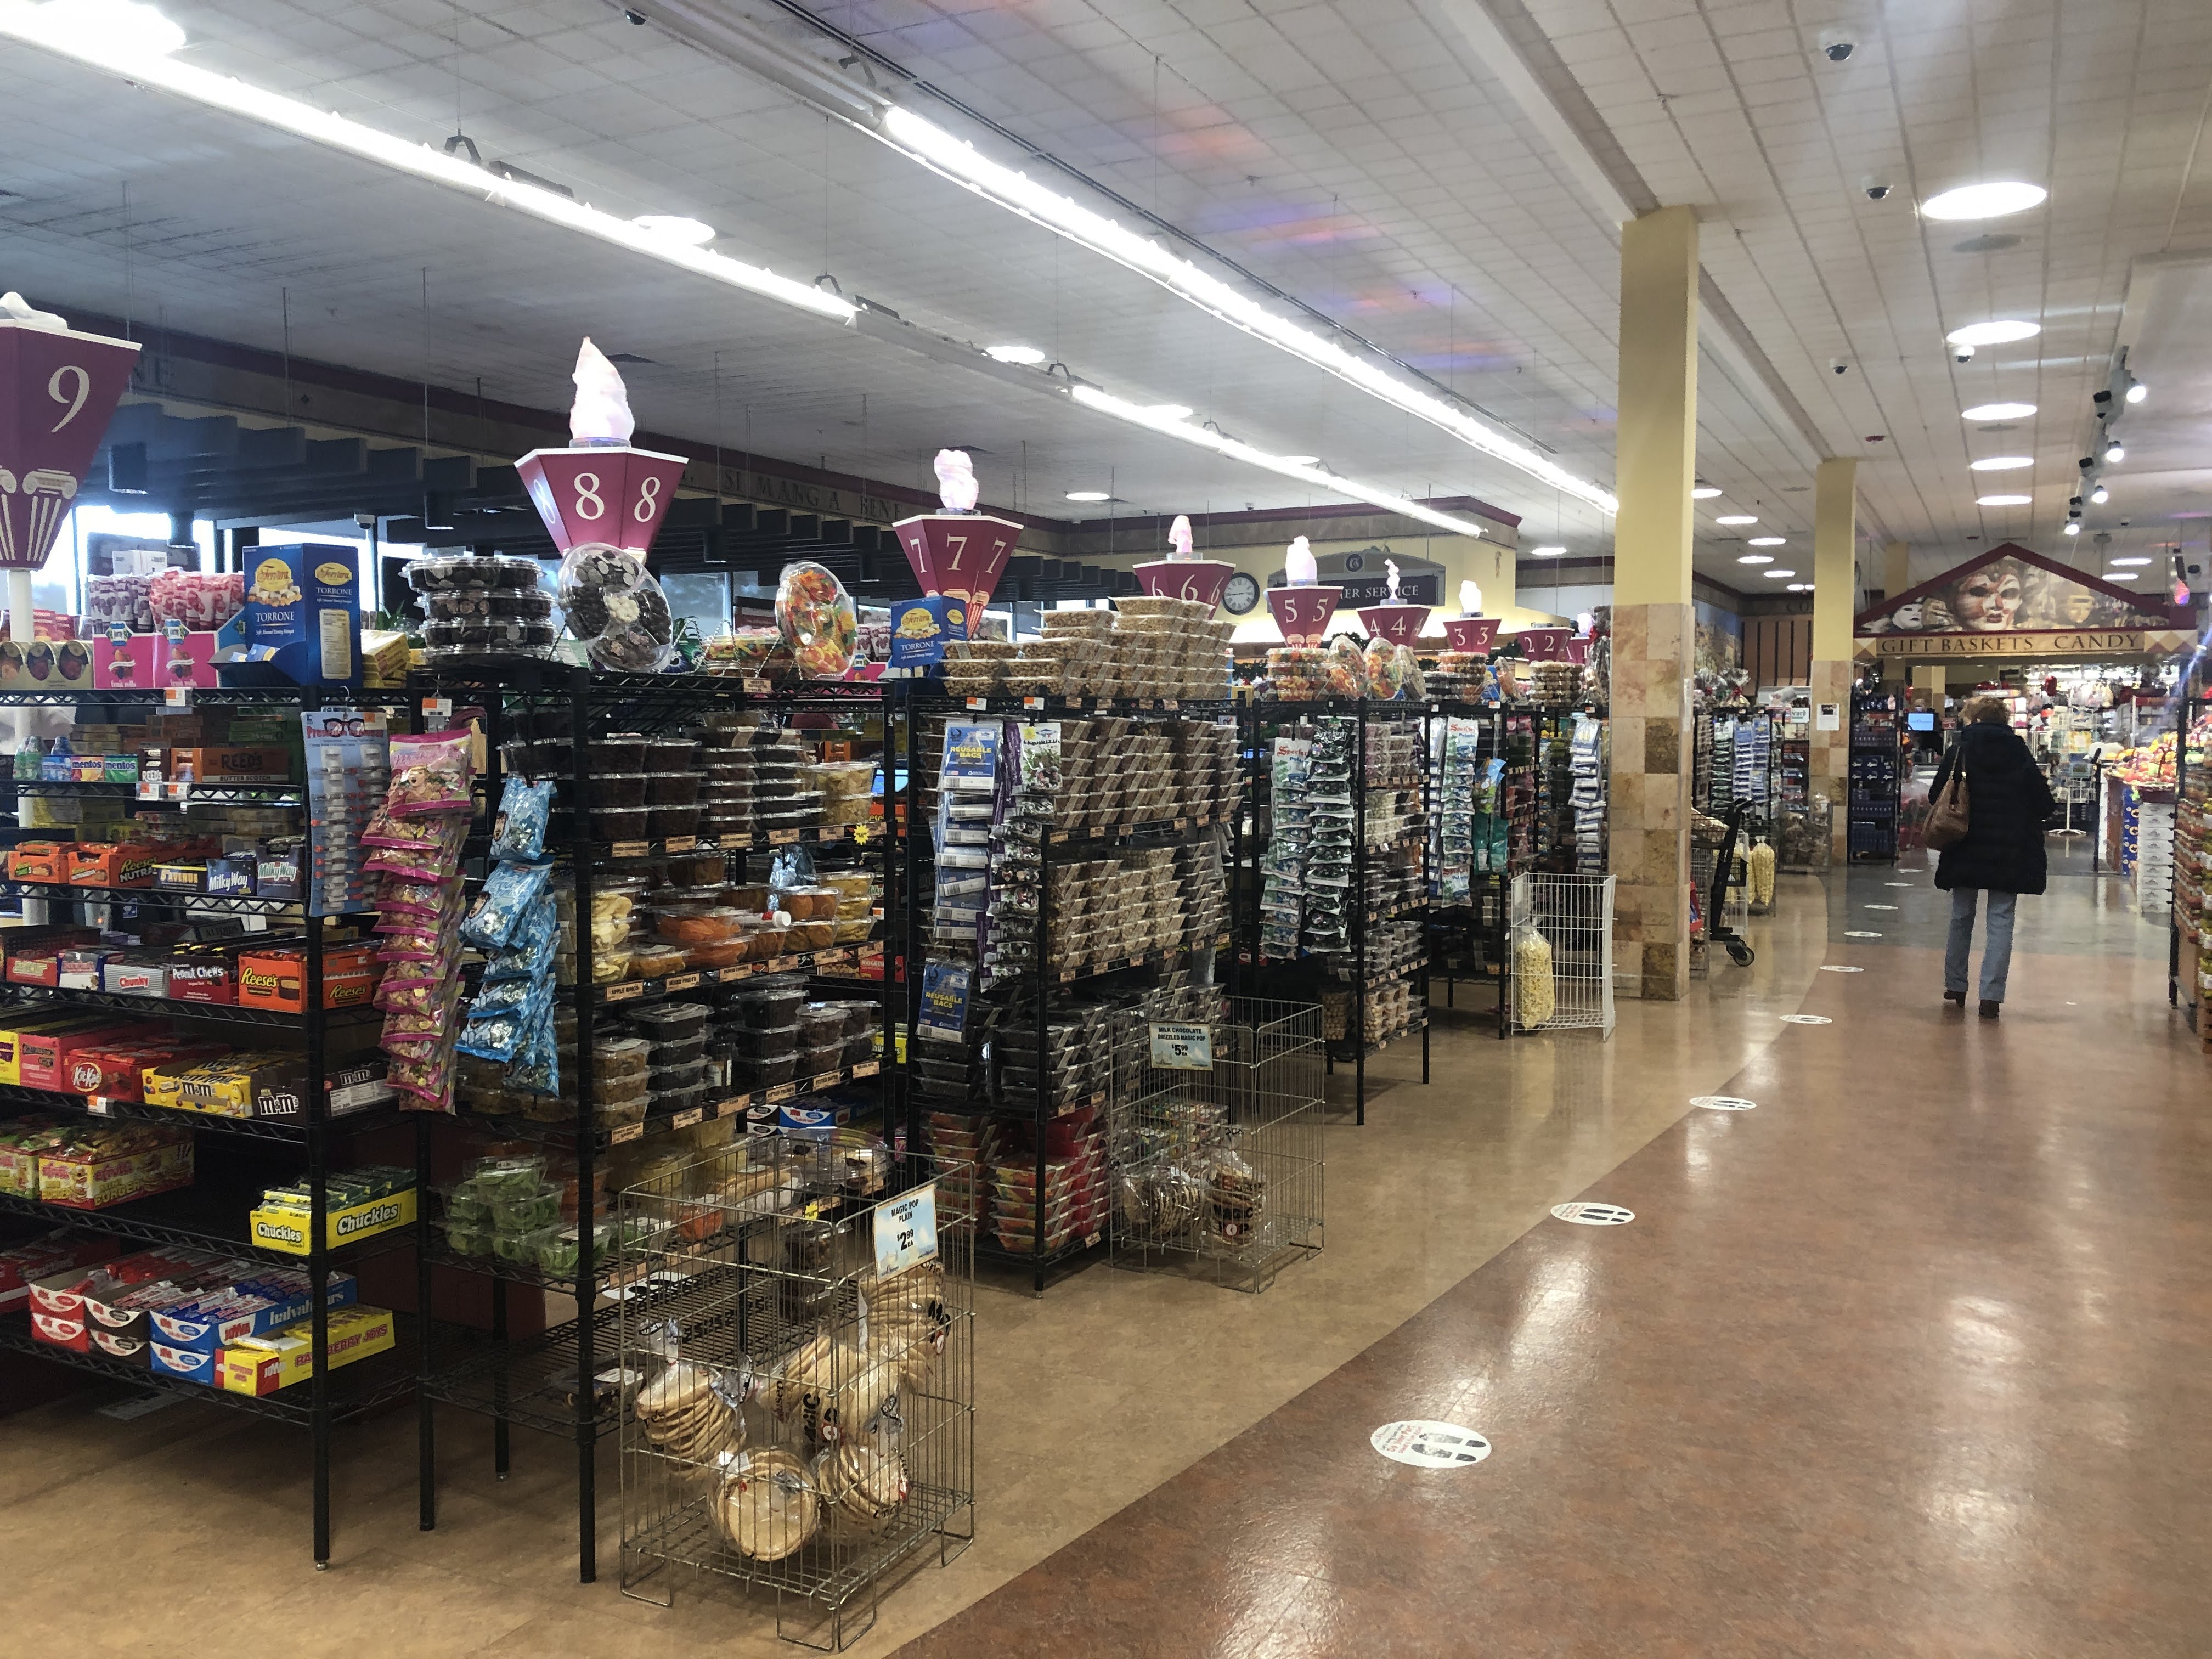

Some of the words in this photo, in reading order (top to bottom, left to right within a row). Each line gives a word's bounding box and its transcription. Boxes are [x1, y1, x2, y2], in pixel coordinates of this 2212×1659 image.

[48, 365, 90, 433] 9
[533, 479, 556, 524] 8
[574, 472, 605, 520] 8
[634, 477, 661, 522] 8
[909, 537, 927, 573] 7
[946, 533, 968, 571] 7
[985, 536, 1007, 574] 7
[316, 586, 352, 595] TORRONE
[1180, 574, 1198, 601] 6
[1210, 576, 1224, 603] 6
[1365, 584, 1419, 598] SERVICE
[255, 611, 295, 622] TORRONE
[1284, 597, 1298, 623] 5
[1312, 597, 1329, 623] 5
[1370, 617, 1380, 638] 4
[1390, 616, 1406, 636] 4
[1454, 627, 1466, 646] 3
[1476, 627, 1489, 645] 3
[1524, 636, 1536, 653] 2
[1543, 635, 1555, 652] 2
[1882, 638, 1934, 652] GIFT
[1942, 636, 2034, 652] BASKETS
[2054, 634, 2139, 650] CANDY
[901, 640, 934, 651] TORRONE
[72, 759, 102, 769] mentos
[105, 760, 136, 770] mentos
[172, 967, 196, 980] Peanut
[196, 965, 224, 979] Chews
[241, 967, 278, 988] Reese's
[119, 976, 149, 988] Chunky
[329, 984, 366, 999] Reese's
[926, 991, 963, 1004] REUSABLE
[933, 1000, 953, 1008] BAGS
[891, 1203, 908, 1217] MAGIC
[909, 1199, 919, 1210] POP
[899, 1211, 913, 1223] PLAIN
[327, 1291, 344, 1306] ars
[362, 1323, 388, 1343] JOYS
